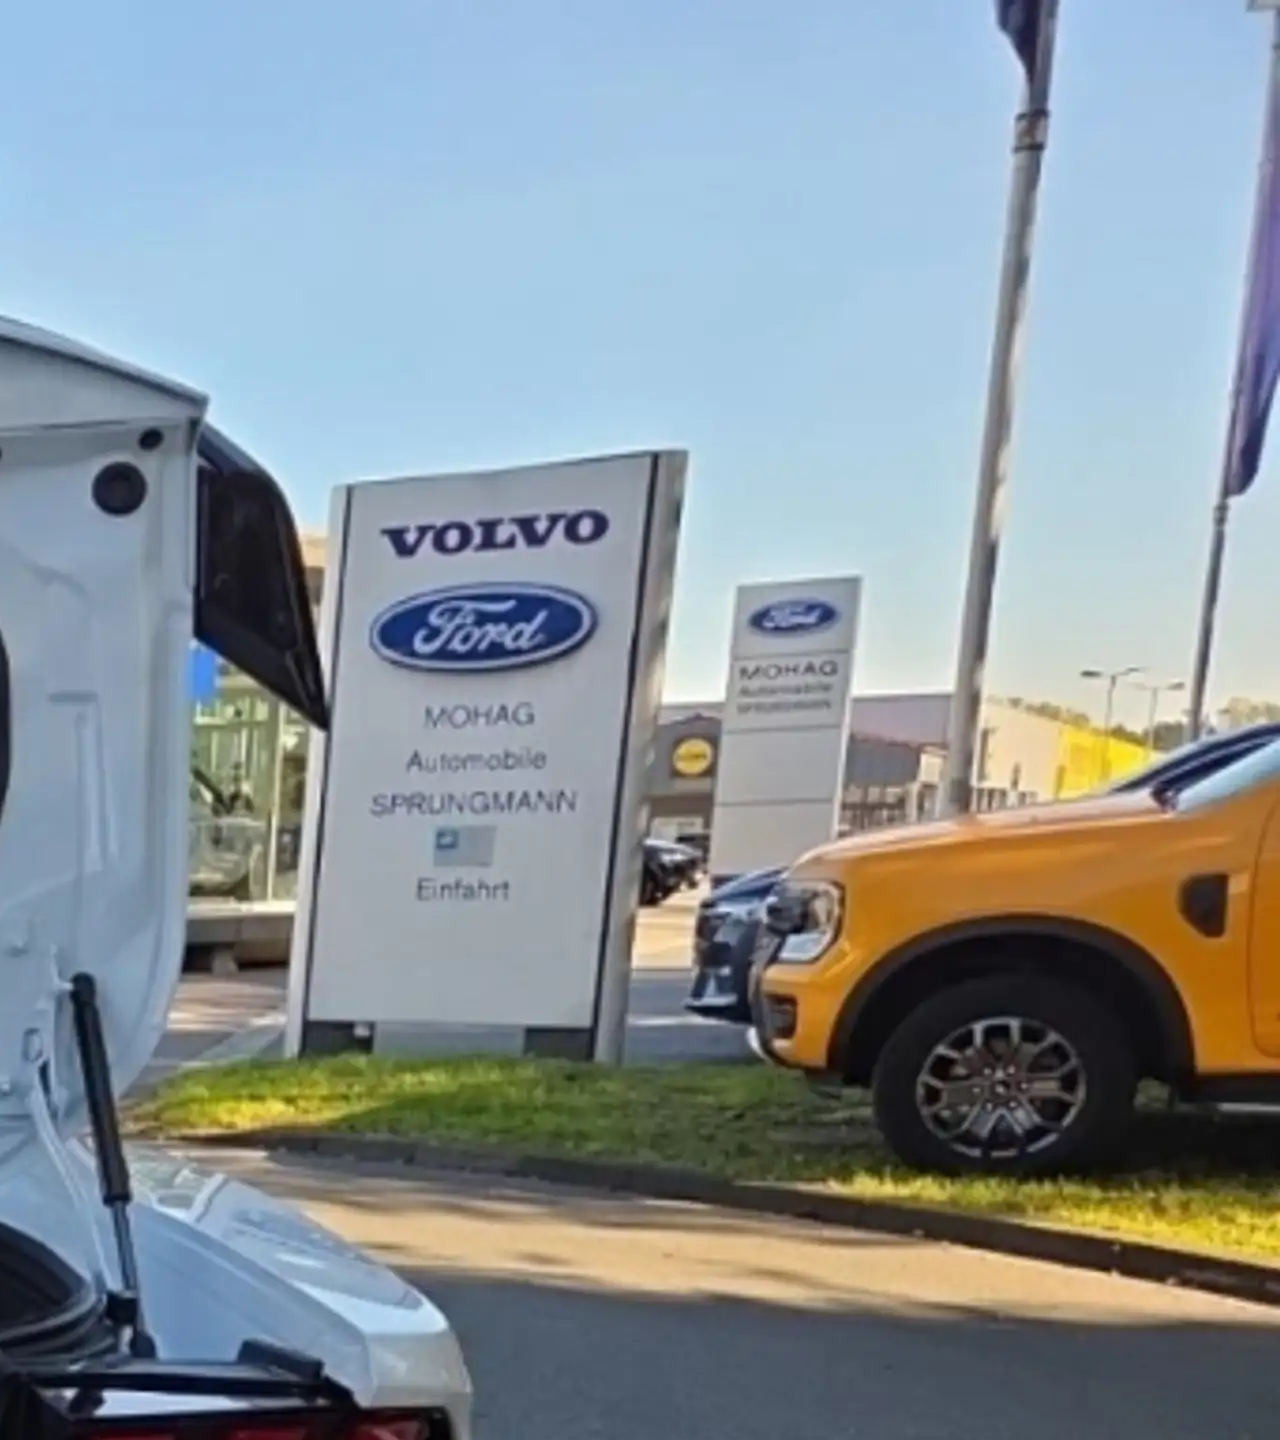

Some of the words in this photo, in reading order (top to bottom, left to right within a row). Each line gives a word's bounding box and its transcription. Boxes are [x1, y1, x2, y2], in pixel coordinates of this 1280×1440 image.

[380, 509, 609, 558] VOLVO
[423, 701, 536, 729] MOHAG
[405, 748, 548, 773] Automobile
[370, 789, 578, 818] SPRUNGMANN
[416, 876, 510, 901] Einfahrt
